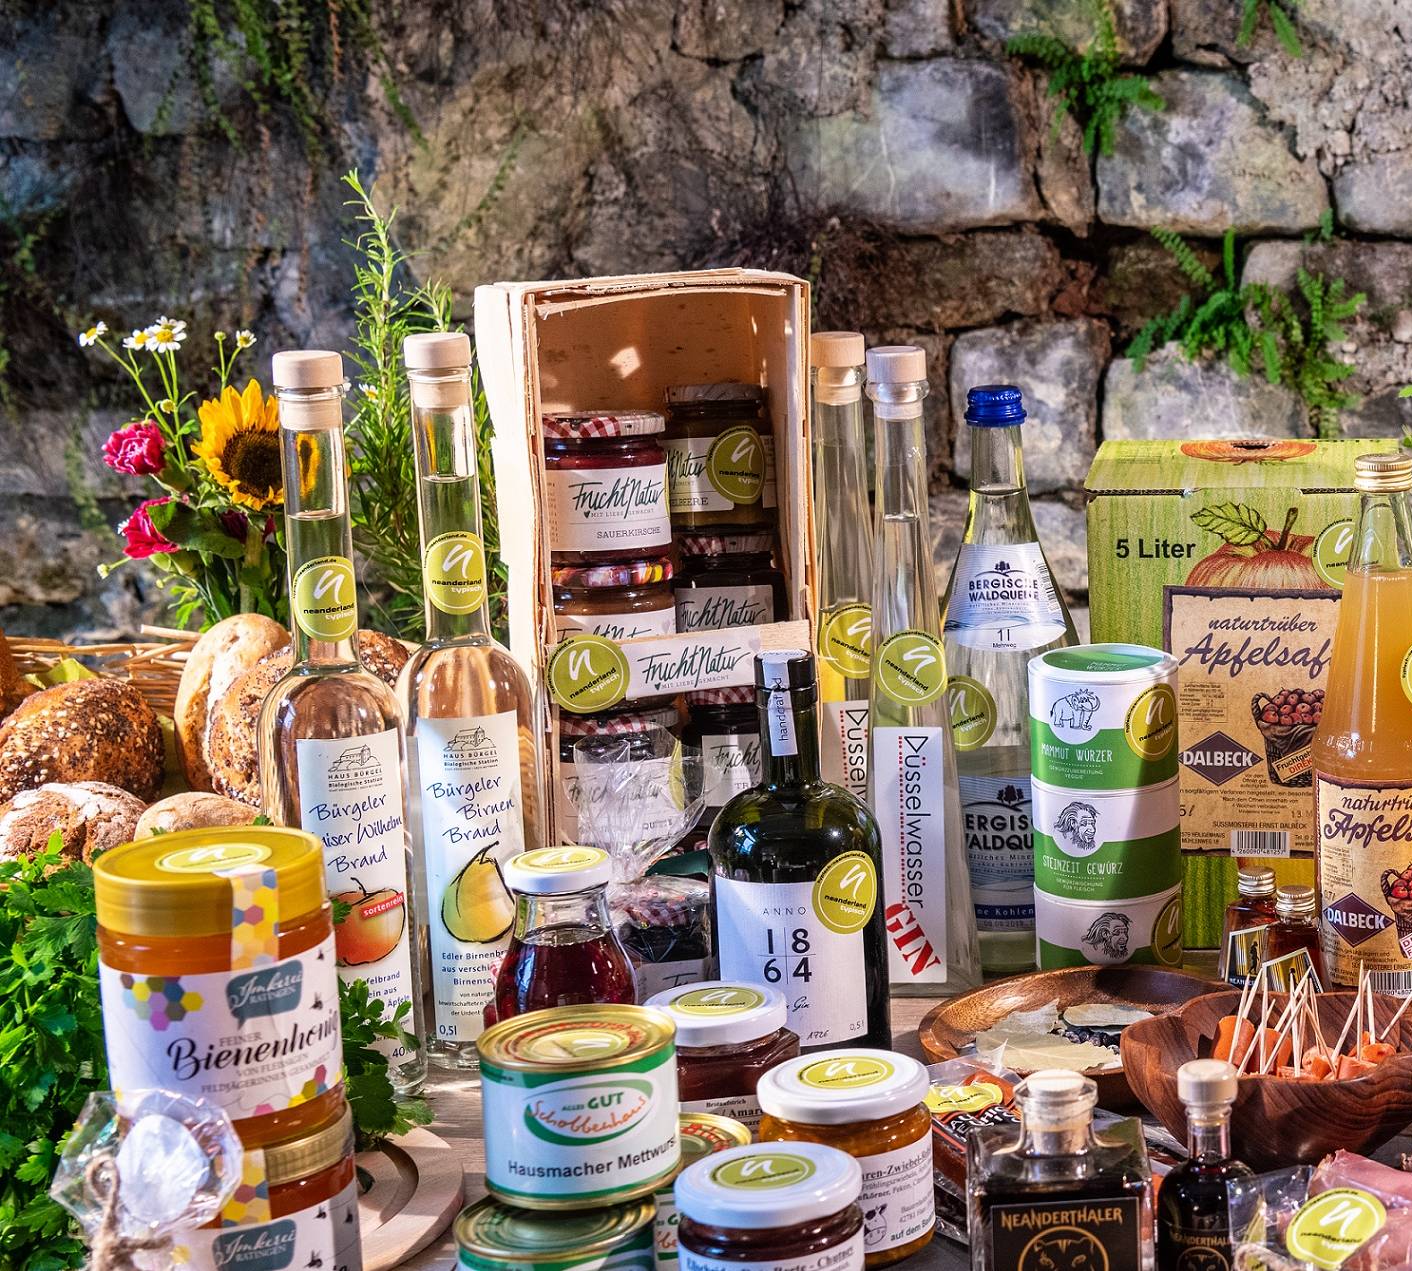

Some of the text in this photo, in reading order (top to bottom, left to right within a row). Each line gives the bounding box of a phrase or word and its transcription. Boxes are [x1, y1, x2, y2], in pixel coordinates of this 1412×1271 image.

[596, 526, 661, 538] SAUERKIRSCHE
[1115, 539, 1196, 559] 5 Liter
[969, 578, 1038, 590] BERGISCE
[304, 602, 355, 615] neanderland
[1208, 612, 1318, 633] naturtrüber
[831, 637, 870, 657] neanderla
[1179, 632, 1333, 680] Apfelsaf
[636, 645, 750, 687] FruchtNatur
[885, 659, 929, 691] neanderland
[570, 667, 616, 699] neanderland
[897, 674, 925, 696] typisch
[952, 712, 985, 729] anderland
[468, 750, 498, 758] BÜRGEL
[710, 741, 760, 775] Frucht
[1042, 744, 1112, 762] MAMMUT WÜRZER
[1183, 751, 1254, 767] DALBECK
[1276, 751, 1312, 771] Fruchtgeh
[354, 768, 382, 778] BÜRGEL
[1288, 759, 1313, 774] DIREK
[364, 777, 383, 785] Station
[426, 776, 502, 800] Bürgeler
[309, 793, 387, 822] Bürgeler
[456, 797, 515, 821] Birnen
[357, 815, 403, 844] Wilhelm
[442, 819, 502, 844] Brand
[903, 735, 932, 909] Düsselwasser
[965, 814, 1029, 831] ERGIS
[966, 833, 1034, 850] ALDQU
[328, 845, 388, 874] Brand
[1042, 855, 1080, 874] STEINZEIT
[1087, 861, 1123, 875] GEWÜRZ
[363, 894, 404, 917] sortenrein
[825, 895, 866, 908] neanderland
[841, 905, 865, 915] typisch
[762, 907, 808, 916] ANNO
[996, 907, 1034, 916] Kohlen
[1327, 908, 1385, 929] DALBECK
[885, 903, 941, 977] GIN
[442, 950, 505, 960] Edler Birnenbr
[459, 964, 490, 972] verschi
[763, 957, 813, 983] 64
[366, 971, 400, 985] felbrand
[219, 1032, 261, 1048] FEINER
[439, 1025, 457, 1036] 0,5l
[167, 1008, 339, 1081] Bienenhonig
[236, 1066, 259, 1078] VON
[587, 1091, 625, 1110] GUT
[508, 1160, 614, 1178] Hausmacher
[1001, 1206, 1123, 1232] NEANDERTHALER
[890, 1223, 921, 1242] auf dem
